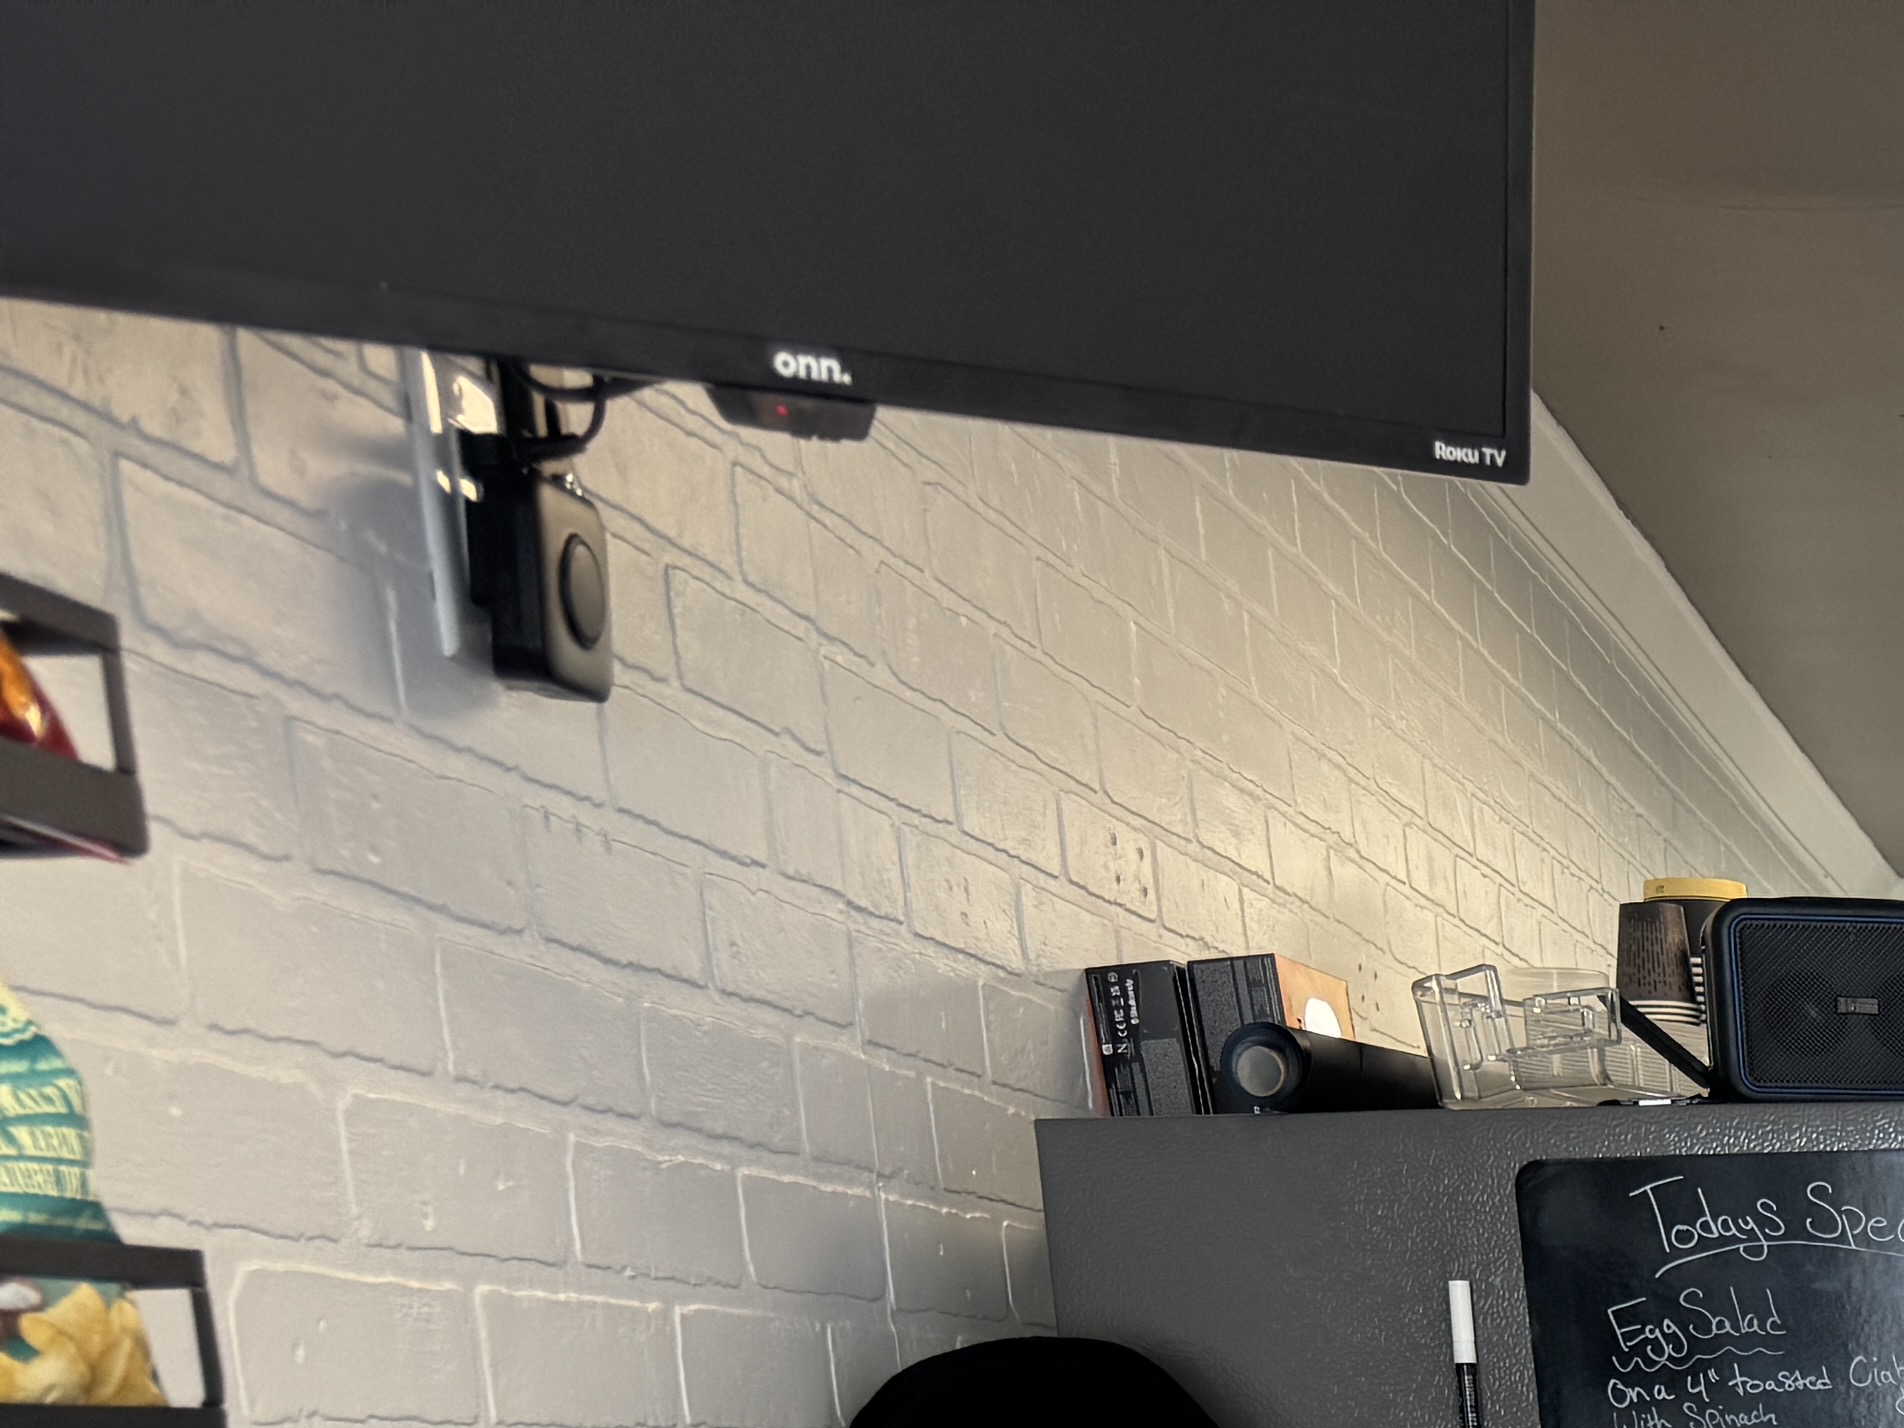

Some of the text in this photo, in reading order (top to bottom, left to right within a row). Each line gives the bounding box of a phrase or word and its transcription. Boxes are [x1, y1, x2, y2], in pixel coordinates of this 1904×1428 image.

[773, 351, 852, 386] onn.
[1481, 447, 1507, 468] TV
[1629, 1175, 1785, 1261] Todays
[1607, 1286, 1787, 1360] Egg Salad
[1728, 1362, 1832, 1396] toasted
